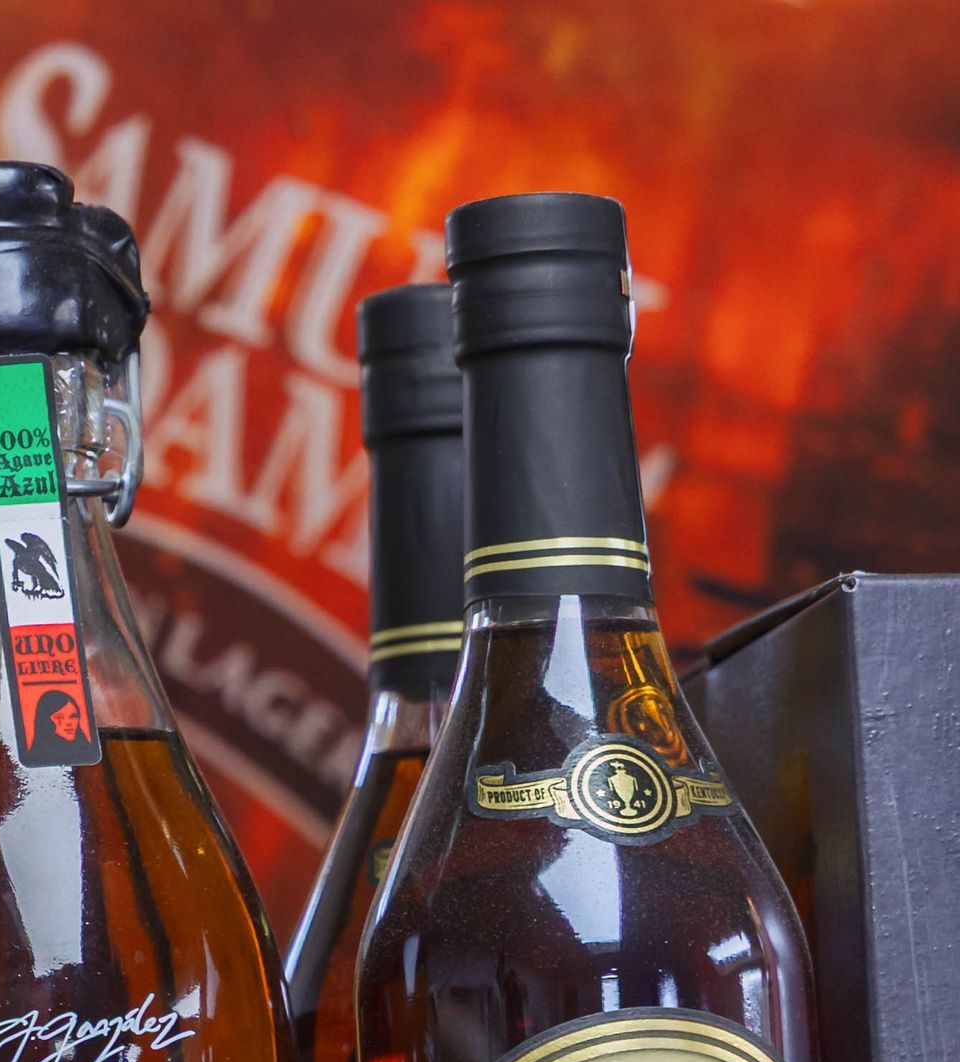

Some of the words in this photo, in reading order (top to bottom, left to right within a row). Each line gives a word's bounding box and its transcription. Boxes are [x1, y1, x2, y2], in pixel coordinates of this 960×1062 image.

[17, 659, 77, 676] LITRE
[487, 789, 531, 803] PRODUCT
[533, 787, 545, 800] OF
